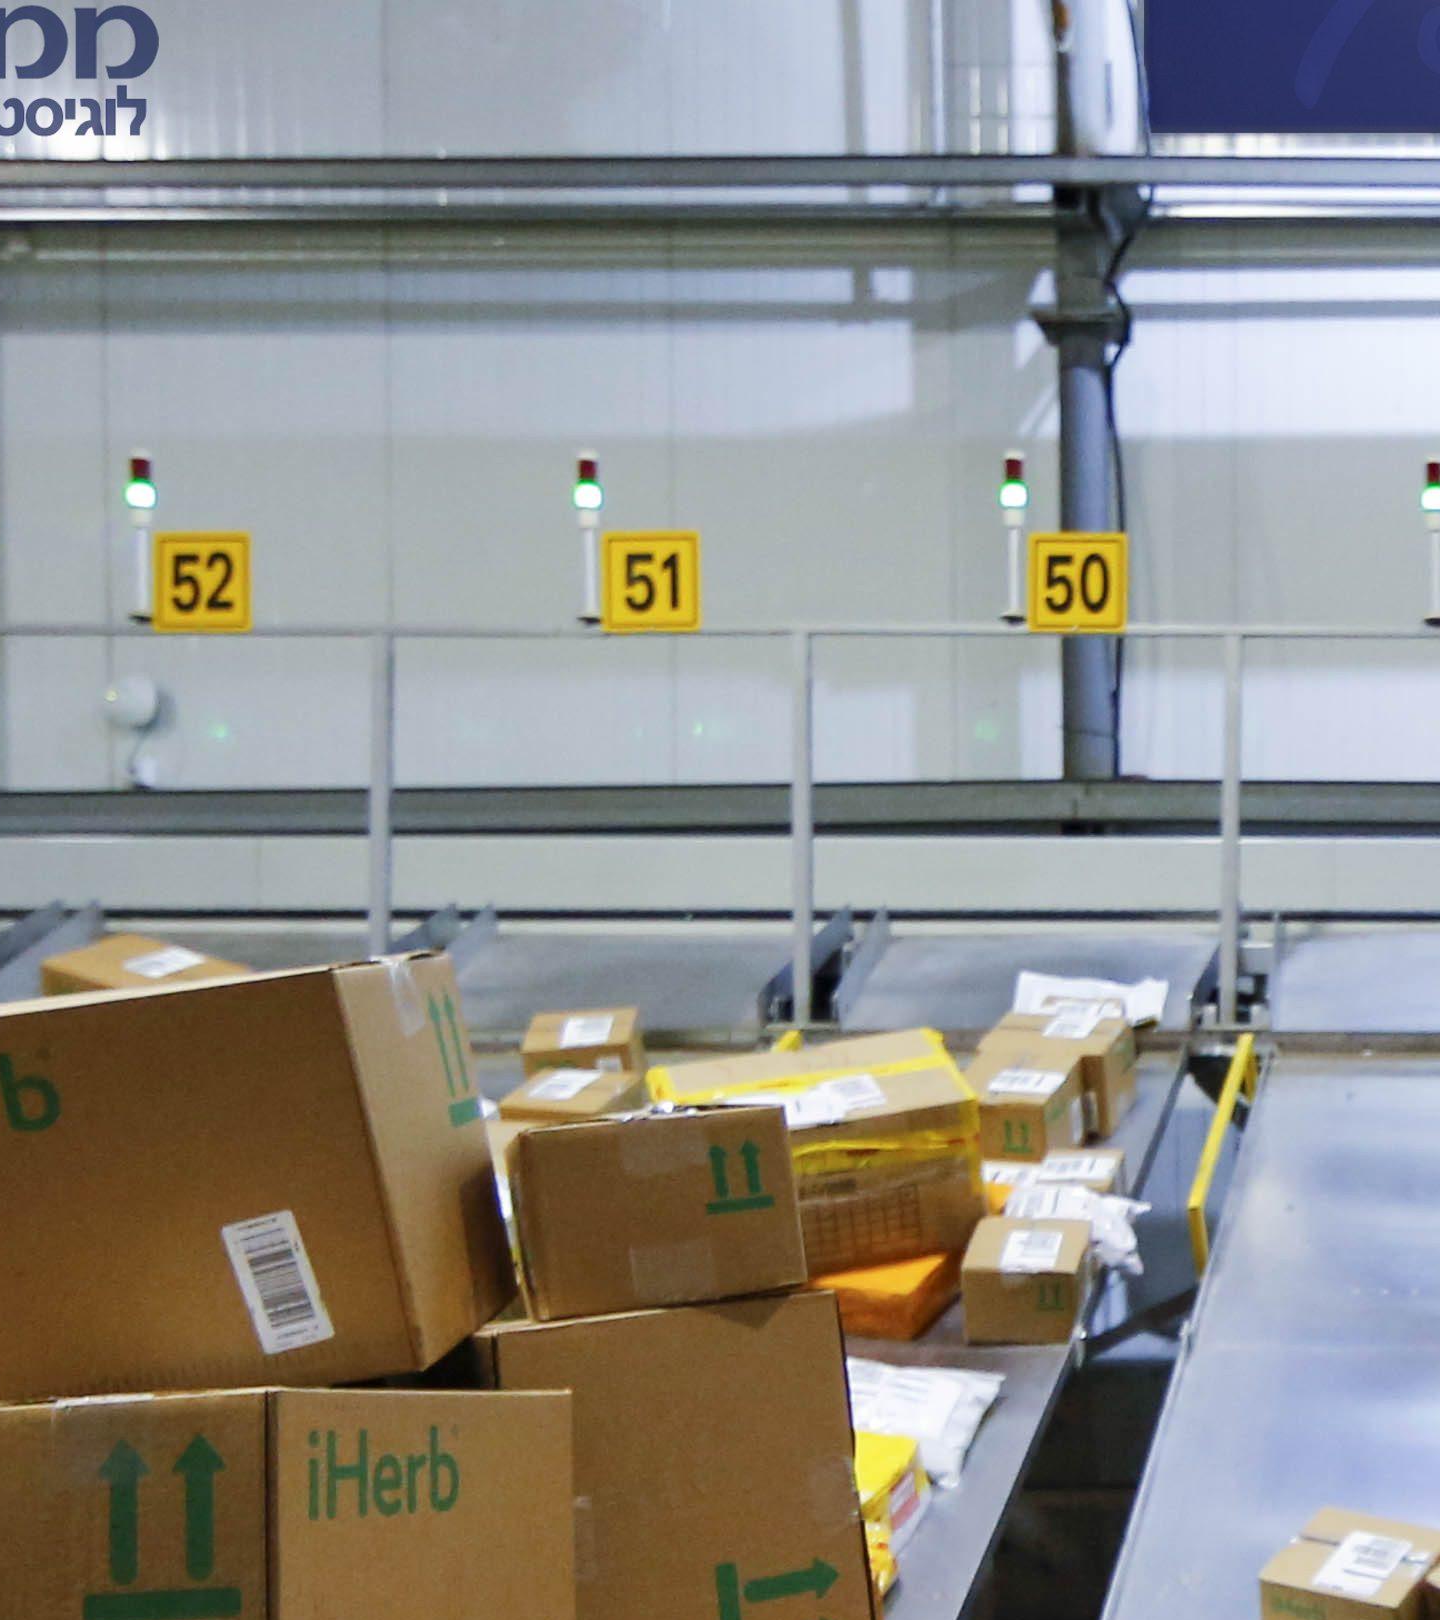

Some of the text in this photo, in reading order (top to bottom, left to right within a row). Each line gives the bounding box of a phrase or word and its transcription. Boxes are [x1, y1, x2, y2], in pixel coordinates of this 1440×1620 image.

[172, 551, 234, 613] 52
[625, 552, 679, 612] 51
[1045, 552, 1110, 614] 50
[307, 1425, 461, 1521] iHerb
